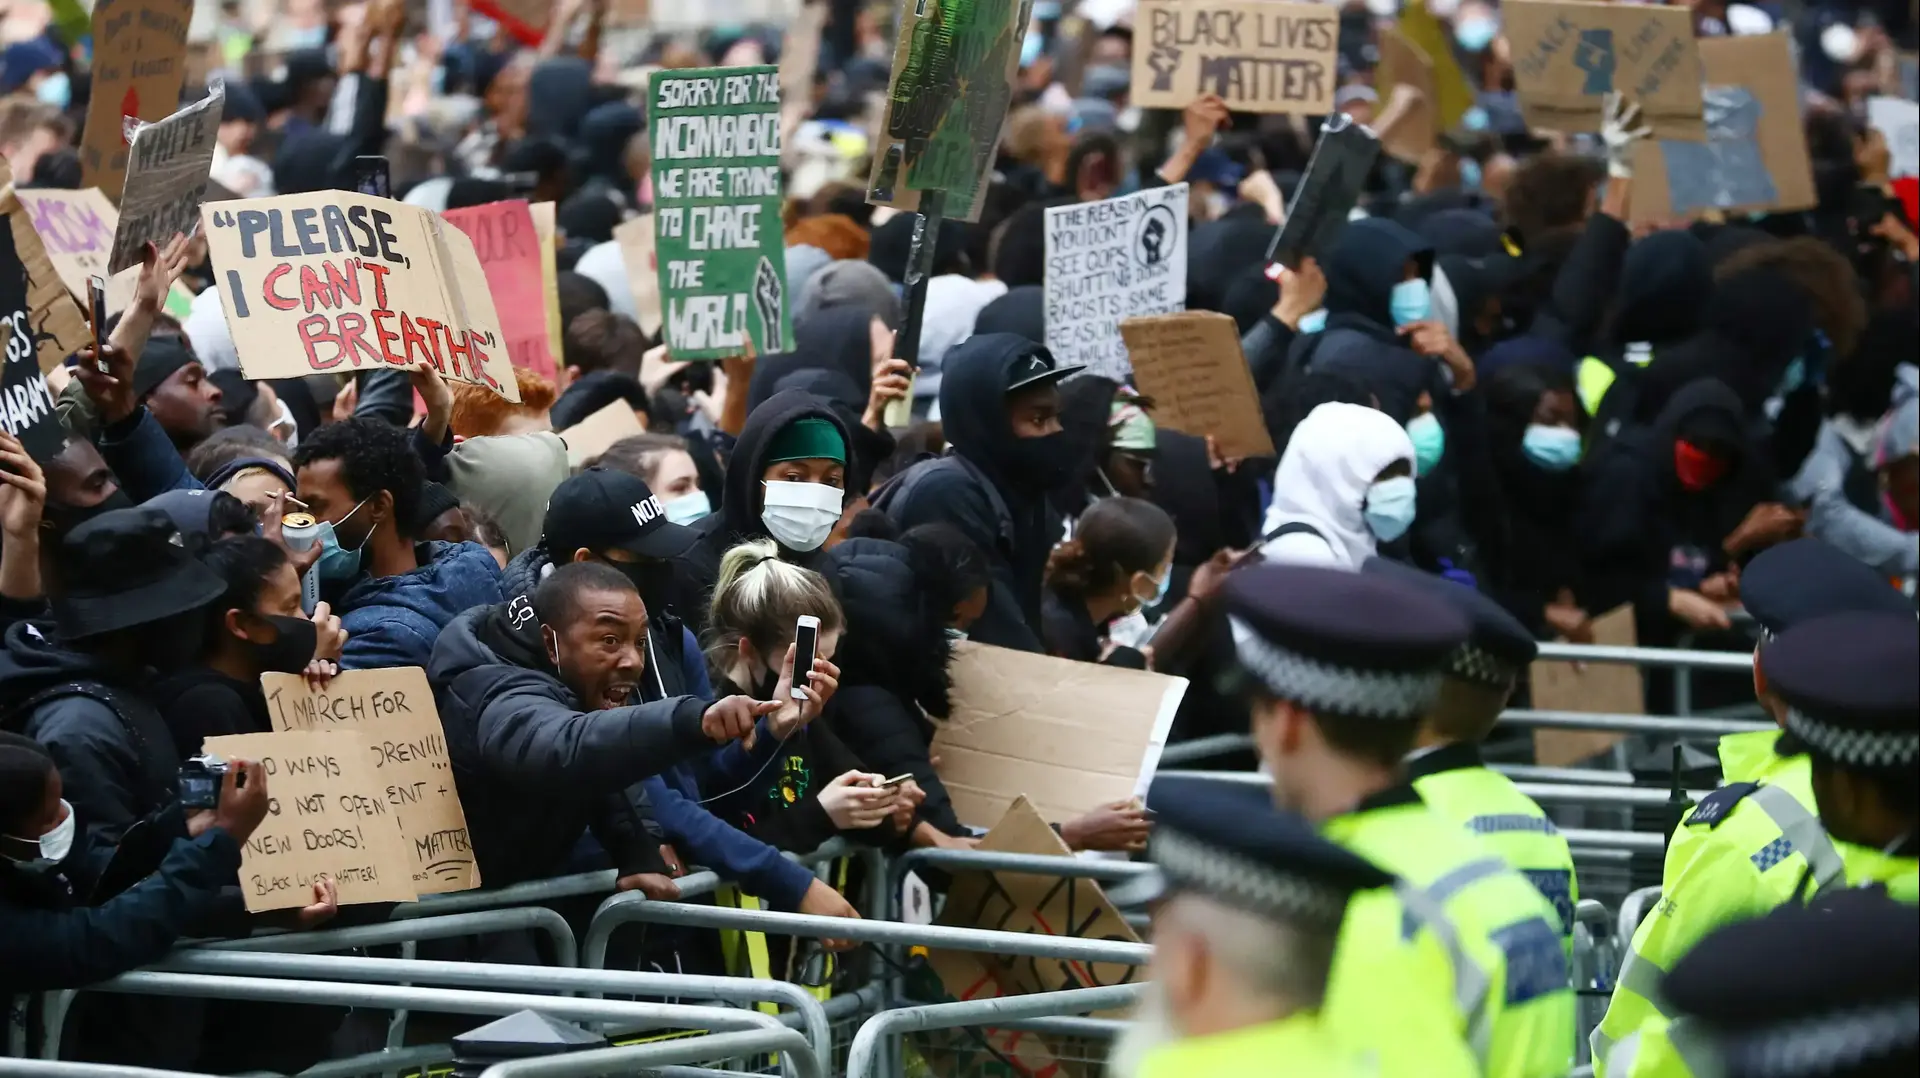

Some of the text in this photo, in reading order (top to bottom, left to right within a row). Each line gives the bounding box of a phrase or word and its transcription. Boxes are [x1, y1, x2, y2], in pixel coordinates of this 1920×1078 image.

[1152, 8, 1335, 51] BLACK LIVES
[657, 78, 721, 108] SORRY
[723, 75, 753, 104] FOR
[1198, 55, 1325, 101] MATTER
[137, 108, 208, 172] WHITE
[659, 166, 779, 198] WE ARE TRYING
[660, 204, 762, 250] TO CHANGE
[1052, 195, 1149, 229] THE REASON
[1051, 230, 1086, 253] YOU
[667, 260, 705, 289] THE
[1048, 246, 1128, 280] SEE COPS
[227, 257, 391, 318] I CAN'T
[1048, 265, 1131, 306] SHUTTING
[668, 293, 748, 350] WORLD
[269, 687, 413, 731] I MARCH FOR
[284, 754, 341, 779] WAYS
[267, 793, 386, 817] O NOT OPEN
[385, 781, 427, 805] ENT
[245, 834, 292, 860] NEW
[303, 824, 366, 851] DOORS!
[414, 827, 473, 863] MATTER
[251, 874, 291, 897] BLACK
[334, 864, 380, 886] MATTER!
